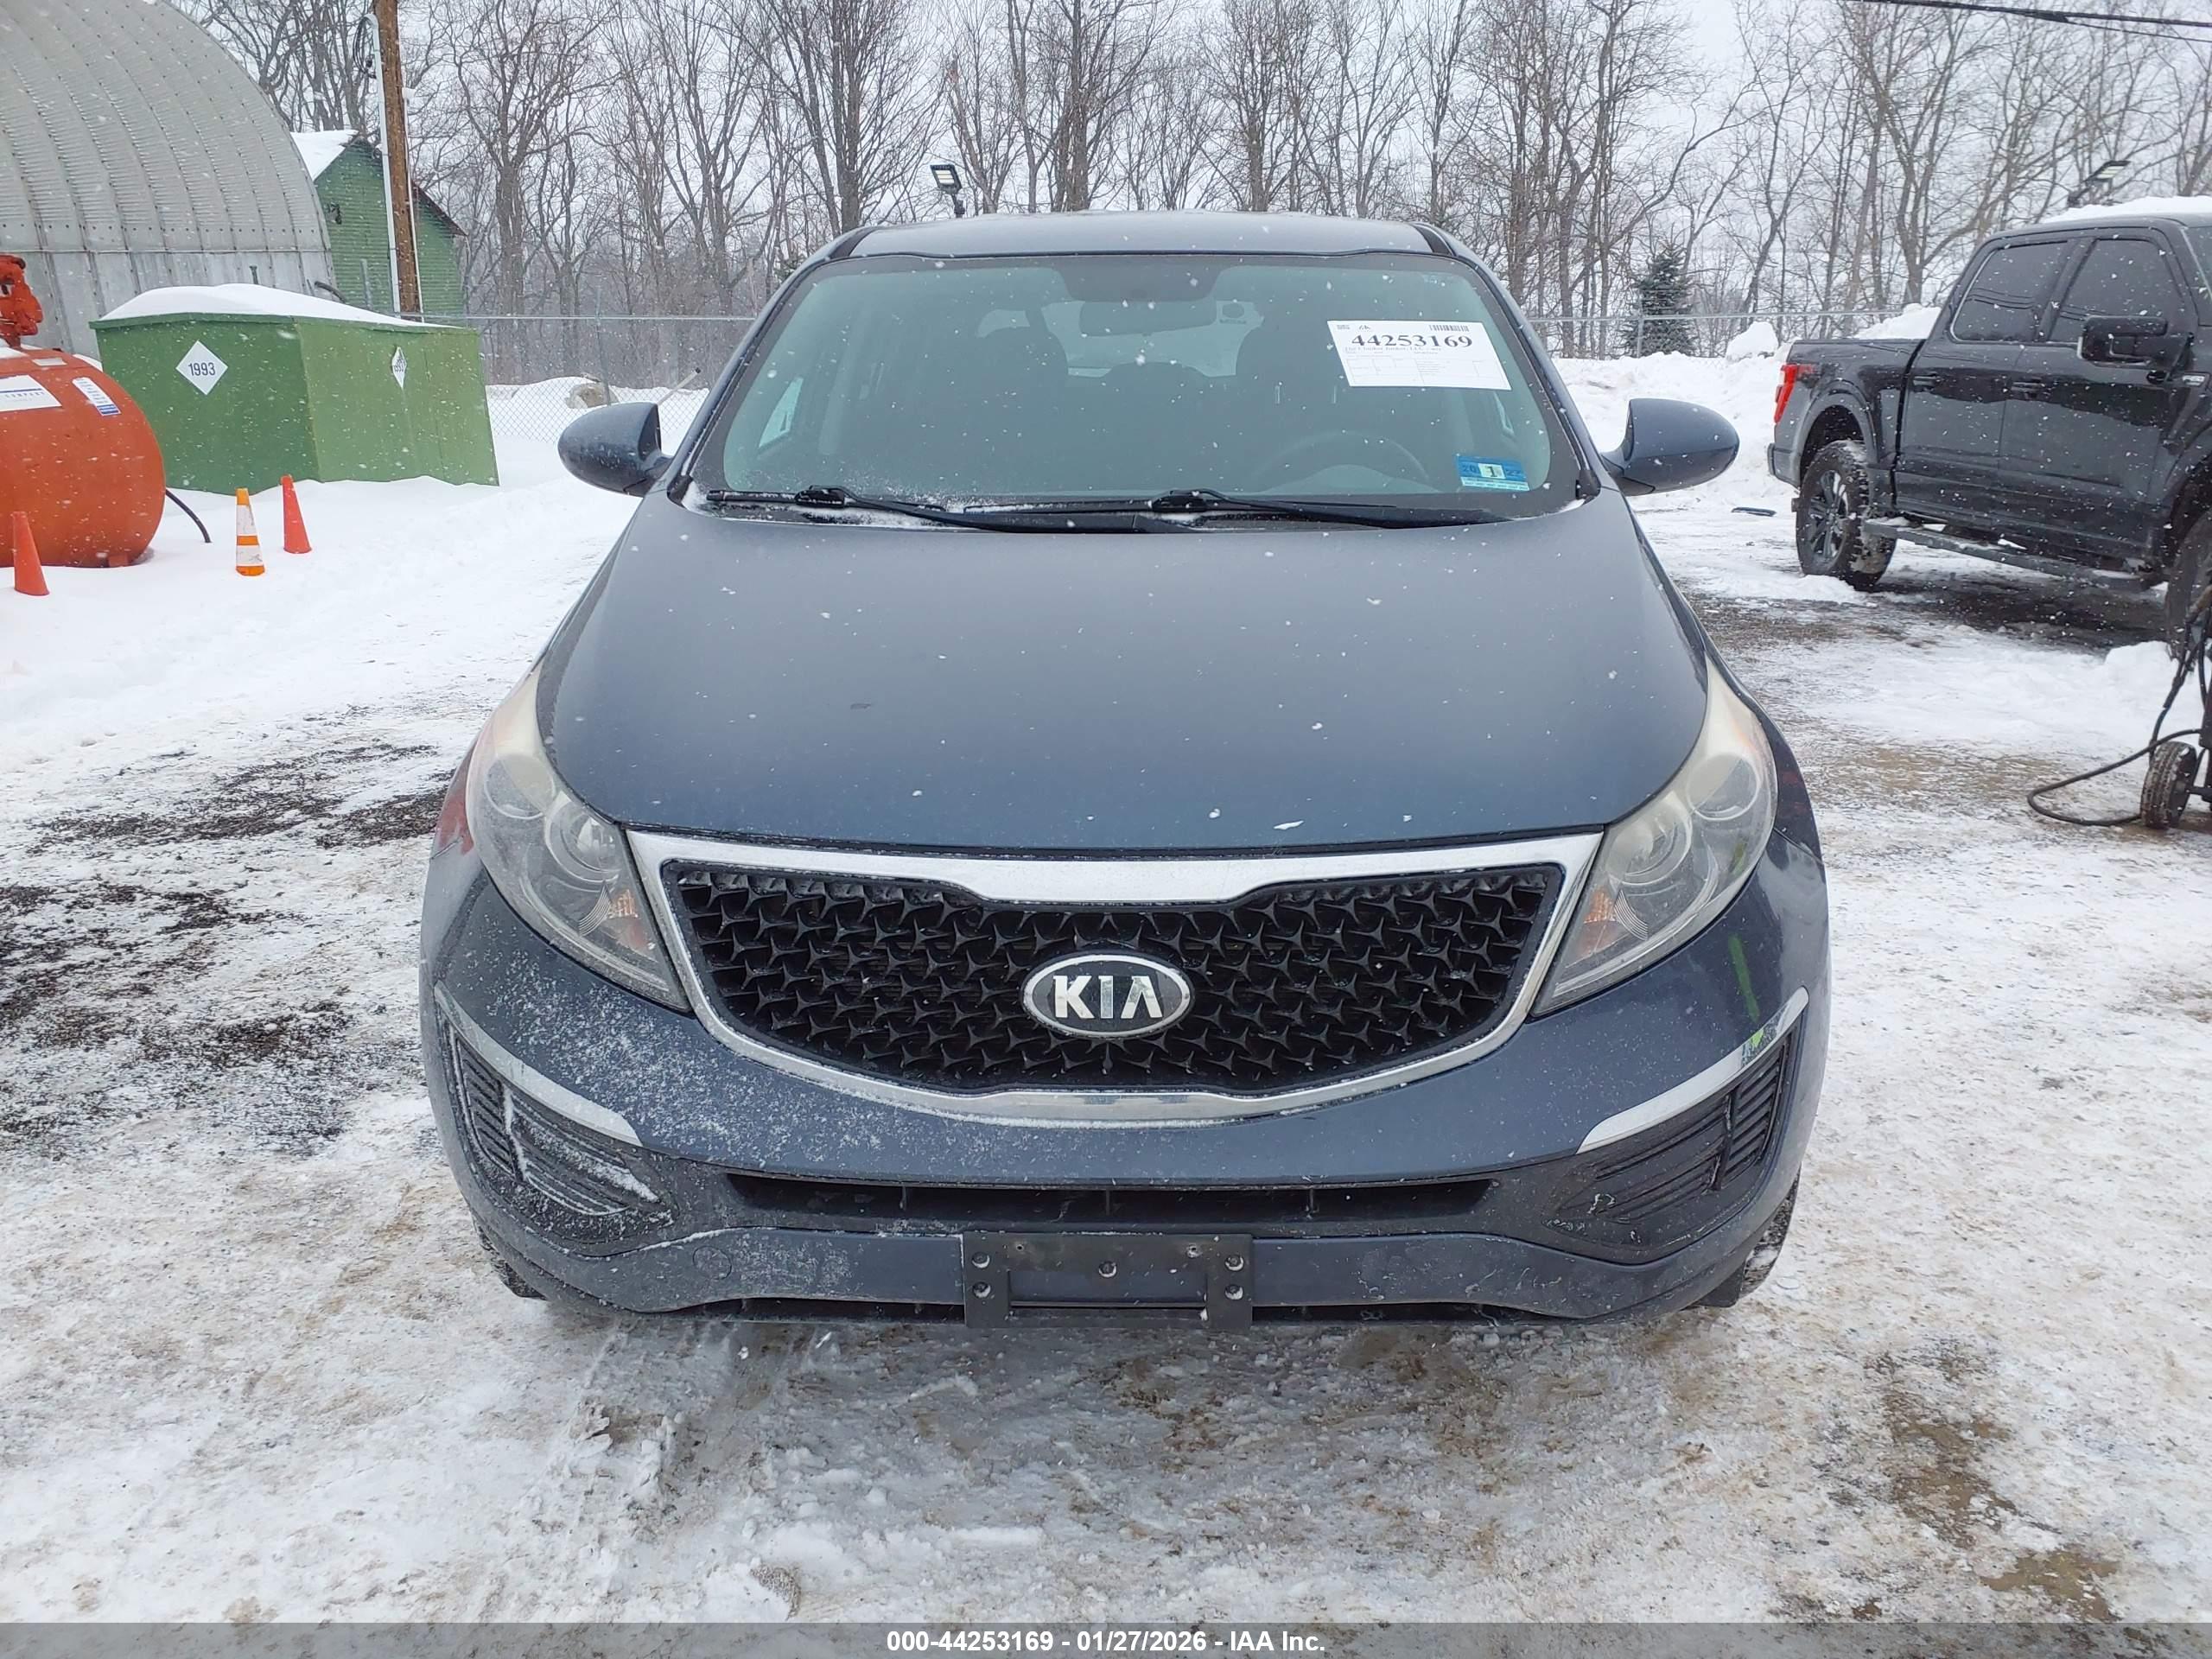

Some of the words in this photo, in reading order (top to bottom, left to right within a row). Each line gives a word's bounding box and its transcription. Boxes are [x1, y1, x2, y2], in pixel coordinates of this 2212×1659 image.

[1351, 334, 1472, 348] 44253169
[188, 362, 216, 377] 1993
[1052, 975, 1163, 1020] KIA
